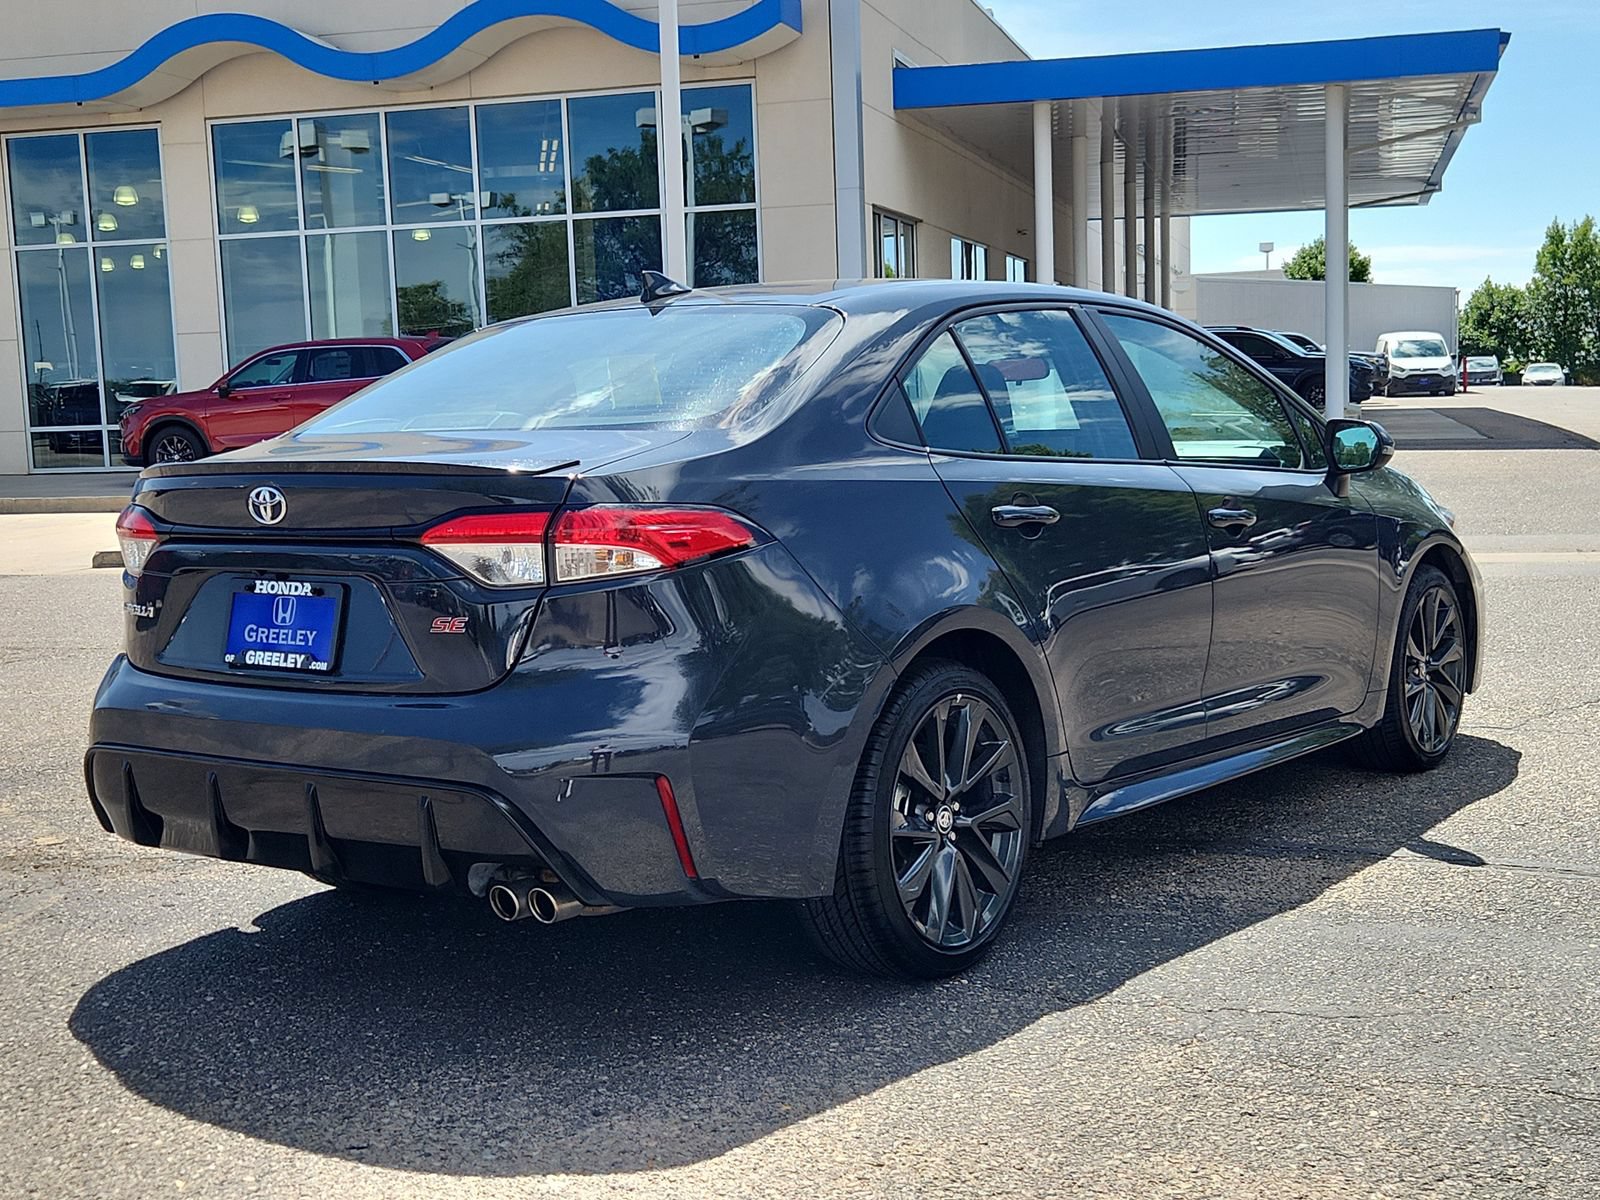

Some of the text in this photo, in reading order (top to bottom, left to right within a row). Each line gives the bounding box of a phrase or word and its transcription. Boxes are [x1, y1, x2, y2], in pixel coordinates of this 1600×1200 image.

[254, 580, 313, 596] HONDA
[430, 616, 469, 633] SE
[244, 624, 318, 647] GREELEY
[224, 653, 235, 663] OF
[245, 650, 306, 669] GREELEY
